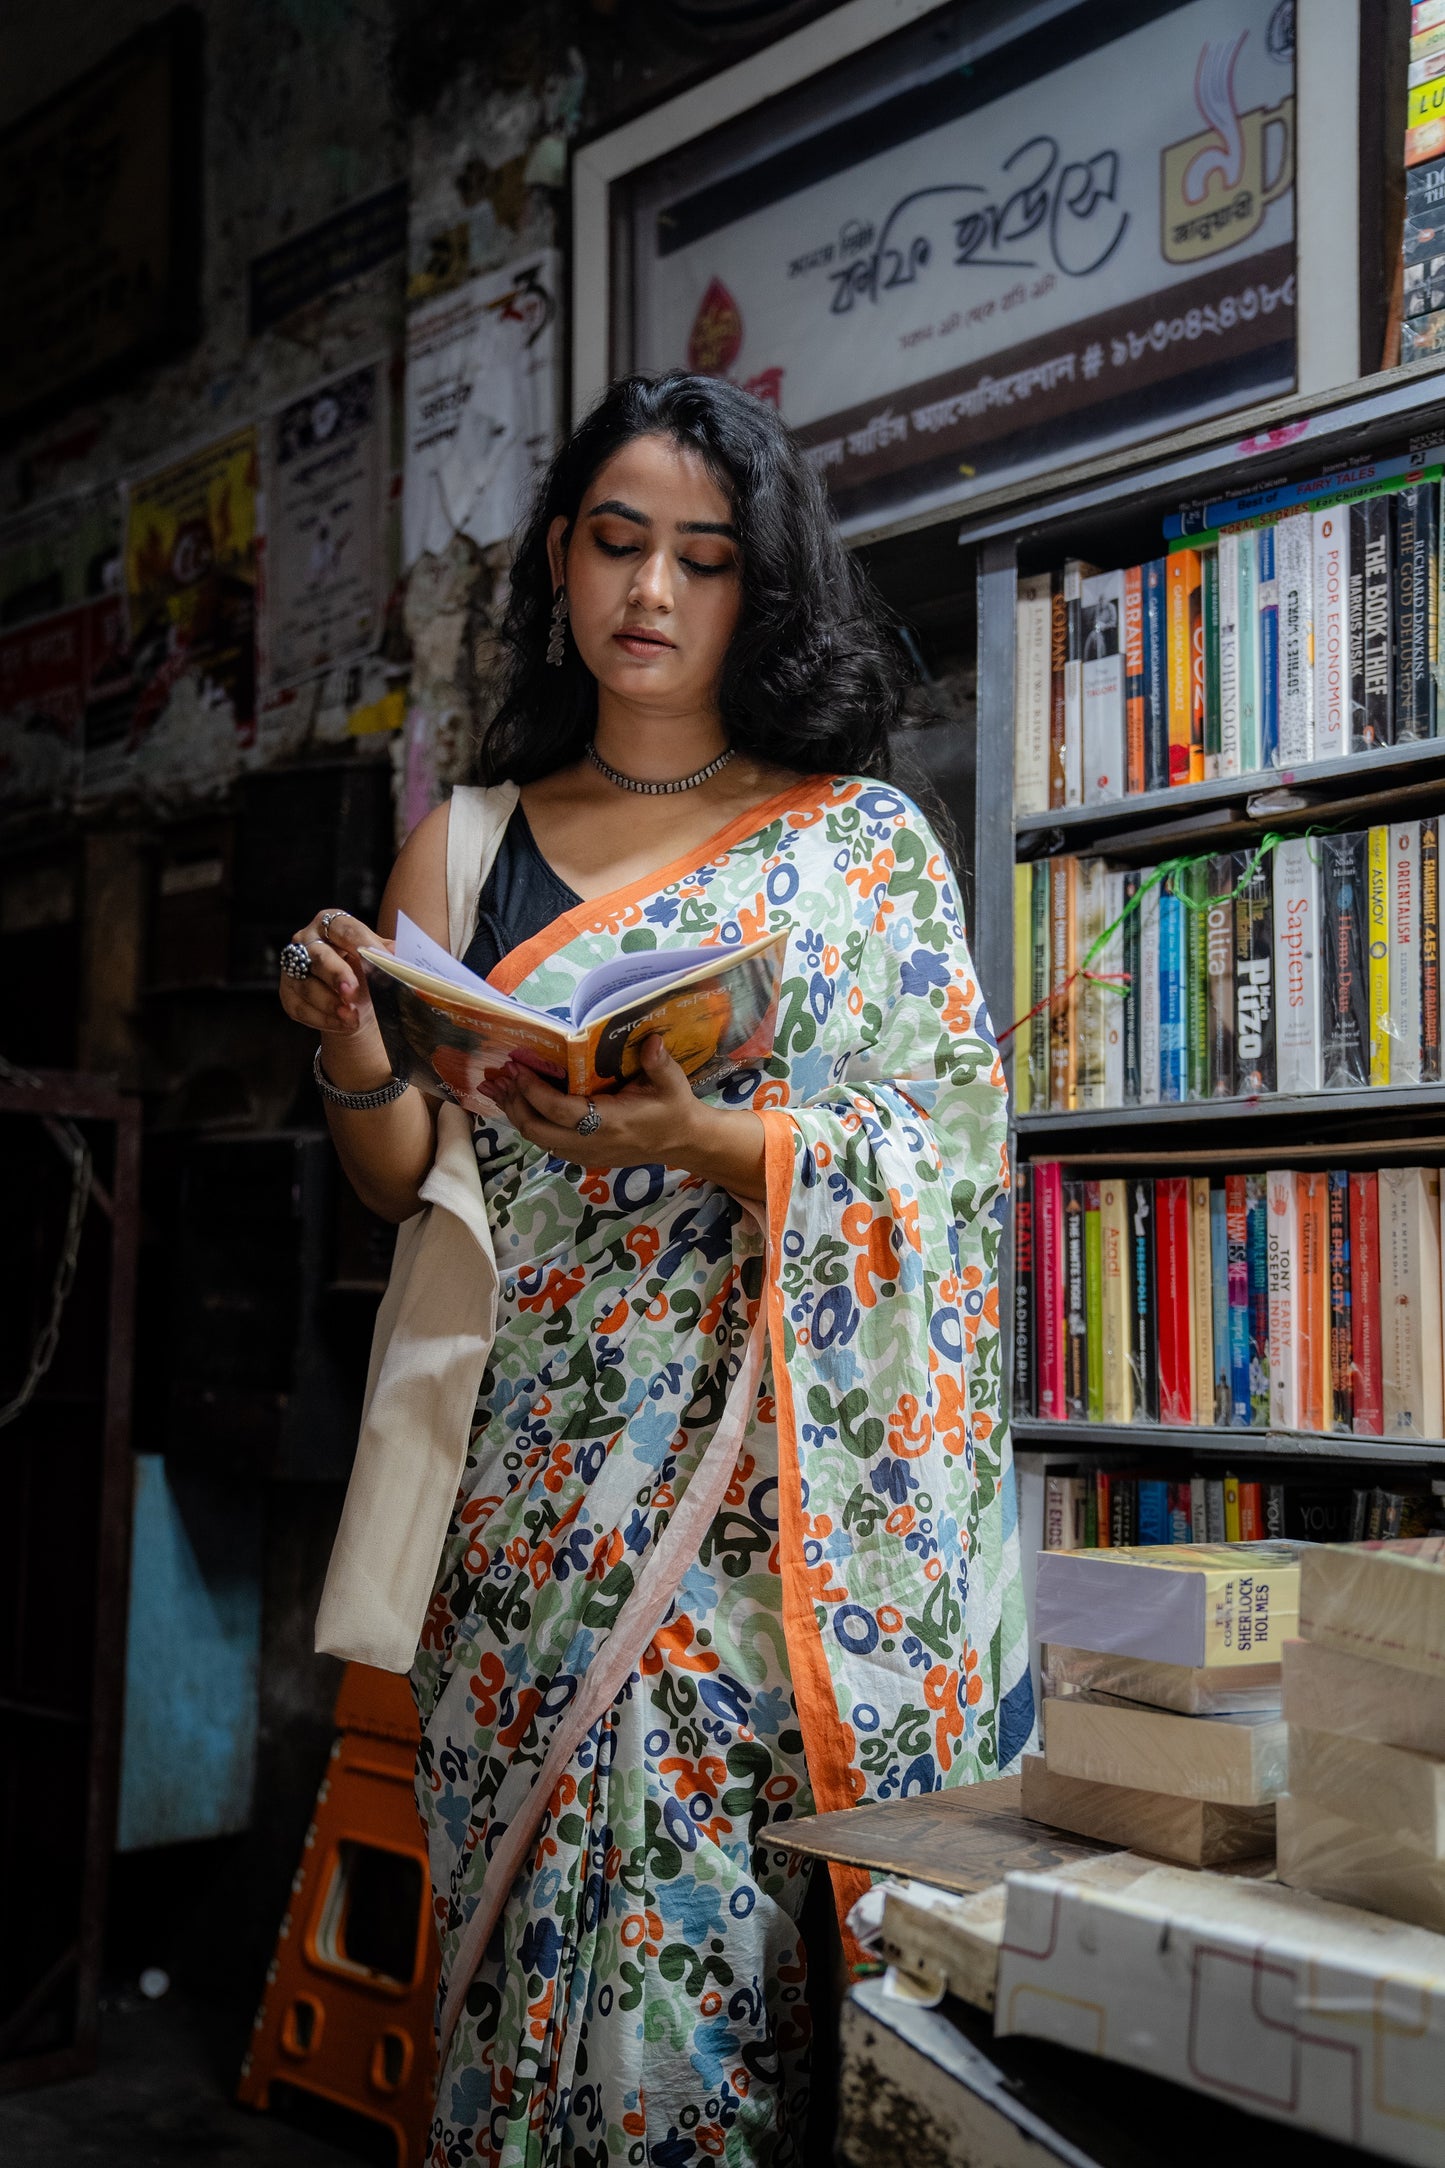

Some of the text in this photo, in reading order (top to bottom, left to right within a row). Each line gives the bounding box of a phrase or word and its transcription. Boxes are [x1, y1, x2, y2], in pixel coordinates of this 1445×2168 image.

[1258, 501, 1310, 526] STORIES
[1297, 477, 1331, 496] FAIRY
[1335, 466, 1376, 485] TALES
[1051, 592, 1067, 673] GODAN
[1125, 593, 1143, 668] BRAIN
[1327, 550, 1341, 733] POOR ECONOMICS
[1350, 573, 1363, 677] MARKUS ZUSAK
[1365, 535, 1387, 696] THE BOOK THIEF
[1400, 520, 1413, 707] THE GOD DELUSION
[1413, 539, 1425, 681] RICHARD DAWKINS
[1222, 641, 1236, 754] KOHINOOR
[1372, 868, 1384, 926] ASIMOV
[1397, 860, 1411, 944] ORIENTALISM
[1423, 858, 1436, 926] FAHRENHEIT
[1281, 898, 1308, 1008] Sapiens
[1338, 915, 1353, 1013] Homo Deus
[1423, 928, 1436, 962] 451
[1424, 965, 1436, 987] RAY
[608, 1006, 668, 1041] শেষের
[675, 982, 734, 1010] কবিতা
[1237, 956, 1271, 1060] Puzo
[1069, 1215, 1080, 1239] THE
[1109, 1228, 1120, 1278] Azadi
[1228, 1211, 1247, 1282] NAMESAKE
[1254, 1208, 1265, 1249] JHUMPA
[1303, 1212, 1312, 1276] CALCUTTA
[1330, 1188, 1344, 1315] THE EPIC CITY
[1016, 1201, 1032, 1384] DEATH SADHGURU
[1070, 1276, 1082, 1311] TIGER
[1136, 1237, 1147, 1314] PERSEPOLIS
[1254, 1252, 1265, 1288] LAHIRI
[1270, 1233, 1280, 1292] JOSEPH
[1280, 1249, 1290, 1292] TONY
[1360, 1271, 1369, 1304] Silence
[1271, 1300, 1281, 1368] INDIANS
[1281, 1300, 1291, 1348] EARLY
[1050, 1491, 1063, 1547] IT ENDS
[1215, 1602, 1224, 1628] TE
[1237, 1577, 1254, 1651] SHERLOCK
[1254, 1584, 1270, 1642] HOLMES
